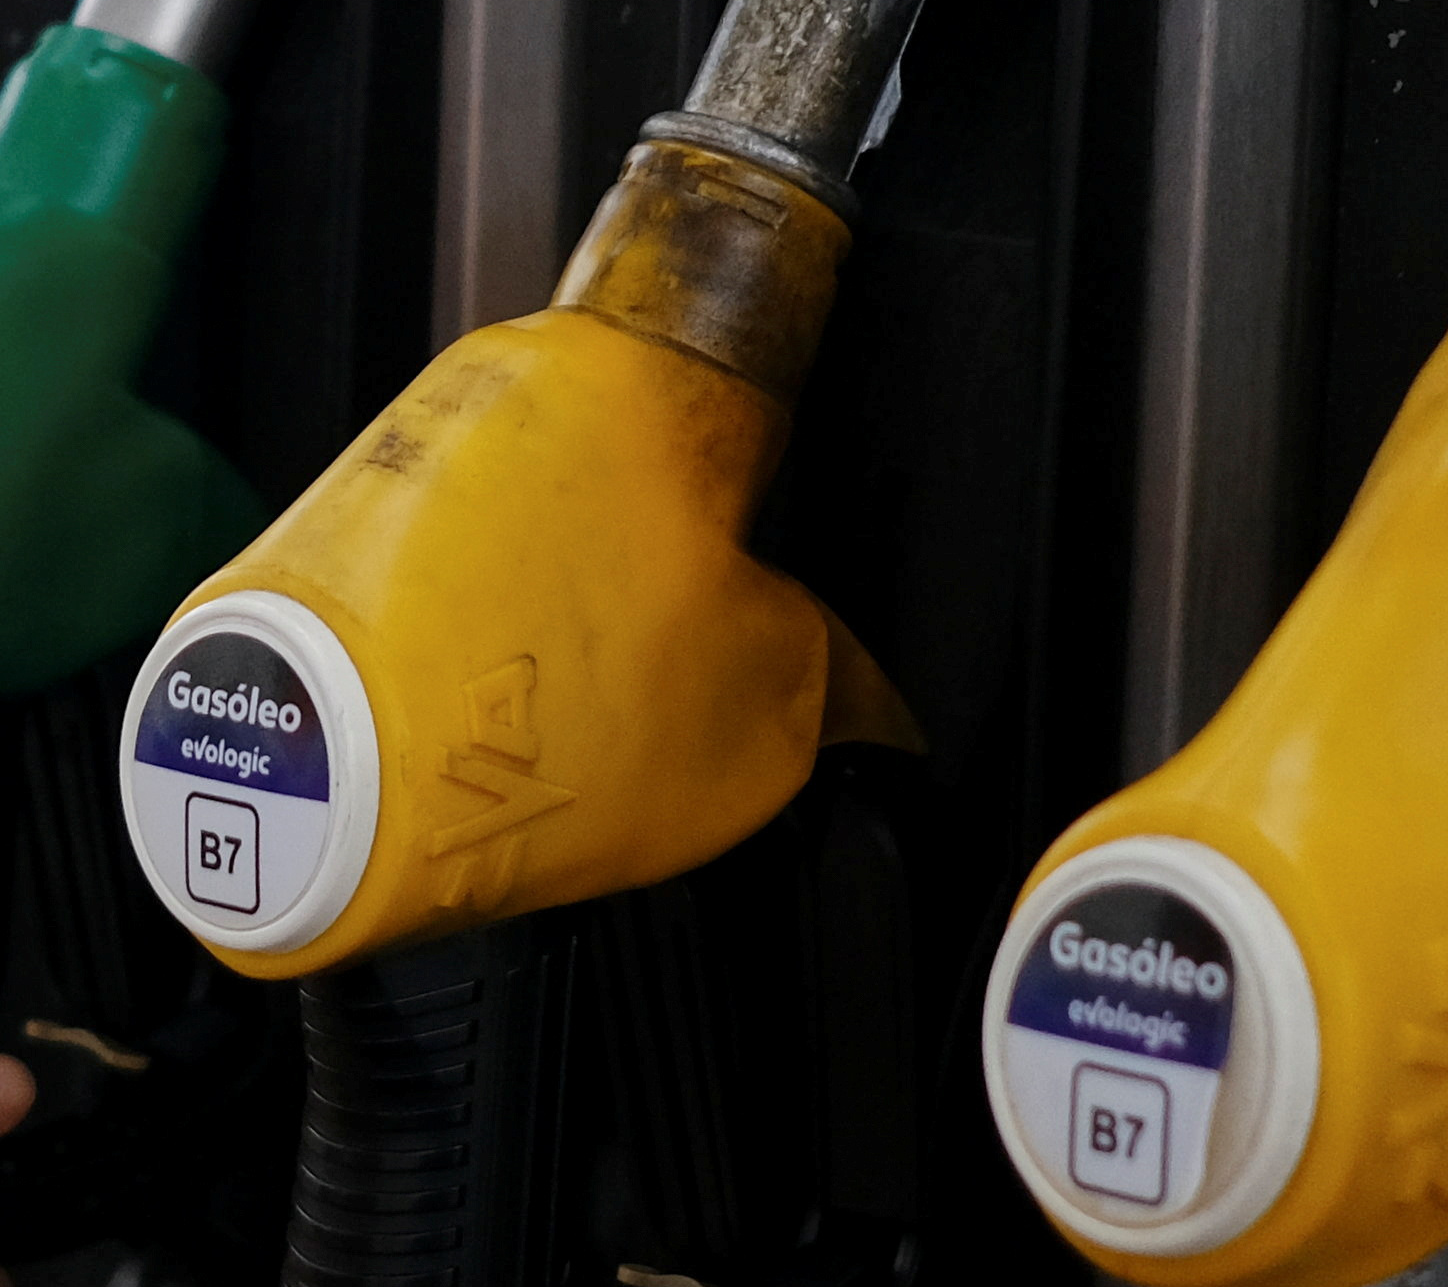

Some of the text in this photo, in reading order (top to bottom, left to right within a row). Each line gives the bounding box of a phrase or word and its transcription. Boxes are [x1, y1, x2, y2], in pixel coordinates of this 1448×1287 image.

[166, 669, 303, 734] Gasóleo
[180, 734, 271, 779] evologic
[199, 828, 243, 875] B7
[1049, 919, 1229, 1000] Gasóleo
[1066, 994, 1190, 1052] evologic
[1089, 1105, 1145, 1159] B7
